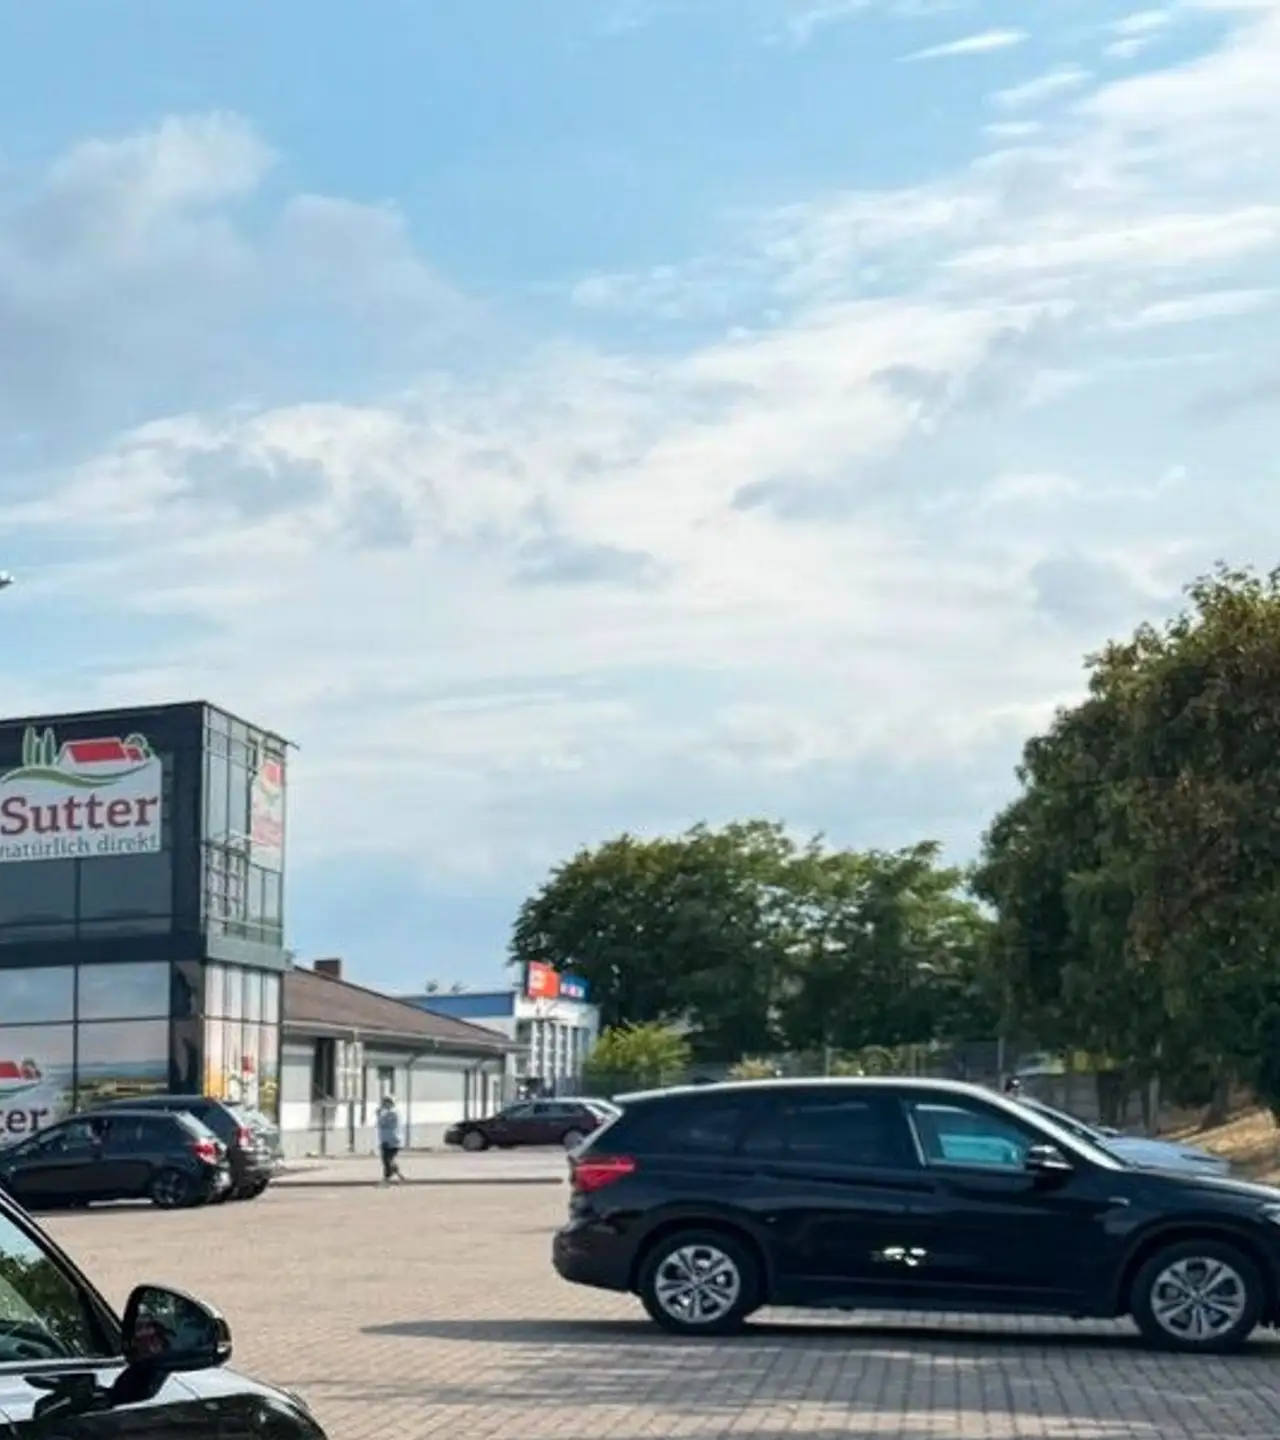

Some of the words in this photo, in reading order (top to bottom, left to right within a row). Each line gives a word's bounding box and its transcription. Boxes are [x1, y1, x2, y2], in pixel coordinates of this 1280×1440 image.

[0, 795, 158, 836] Sutter
[0, 837, 91, 859] natürlich
[97, 833, 158, 855] direkt
